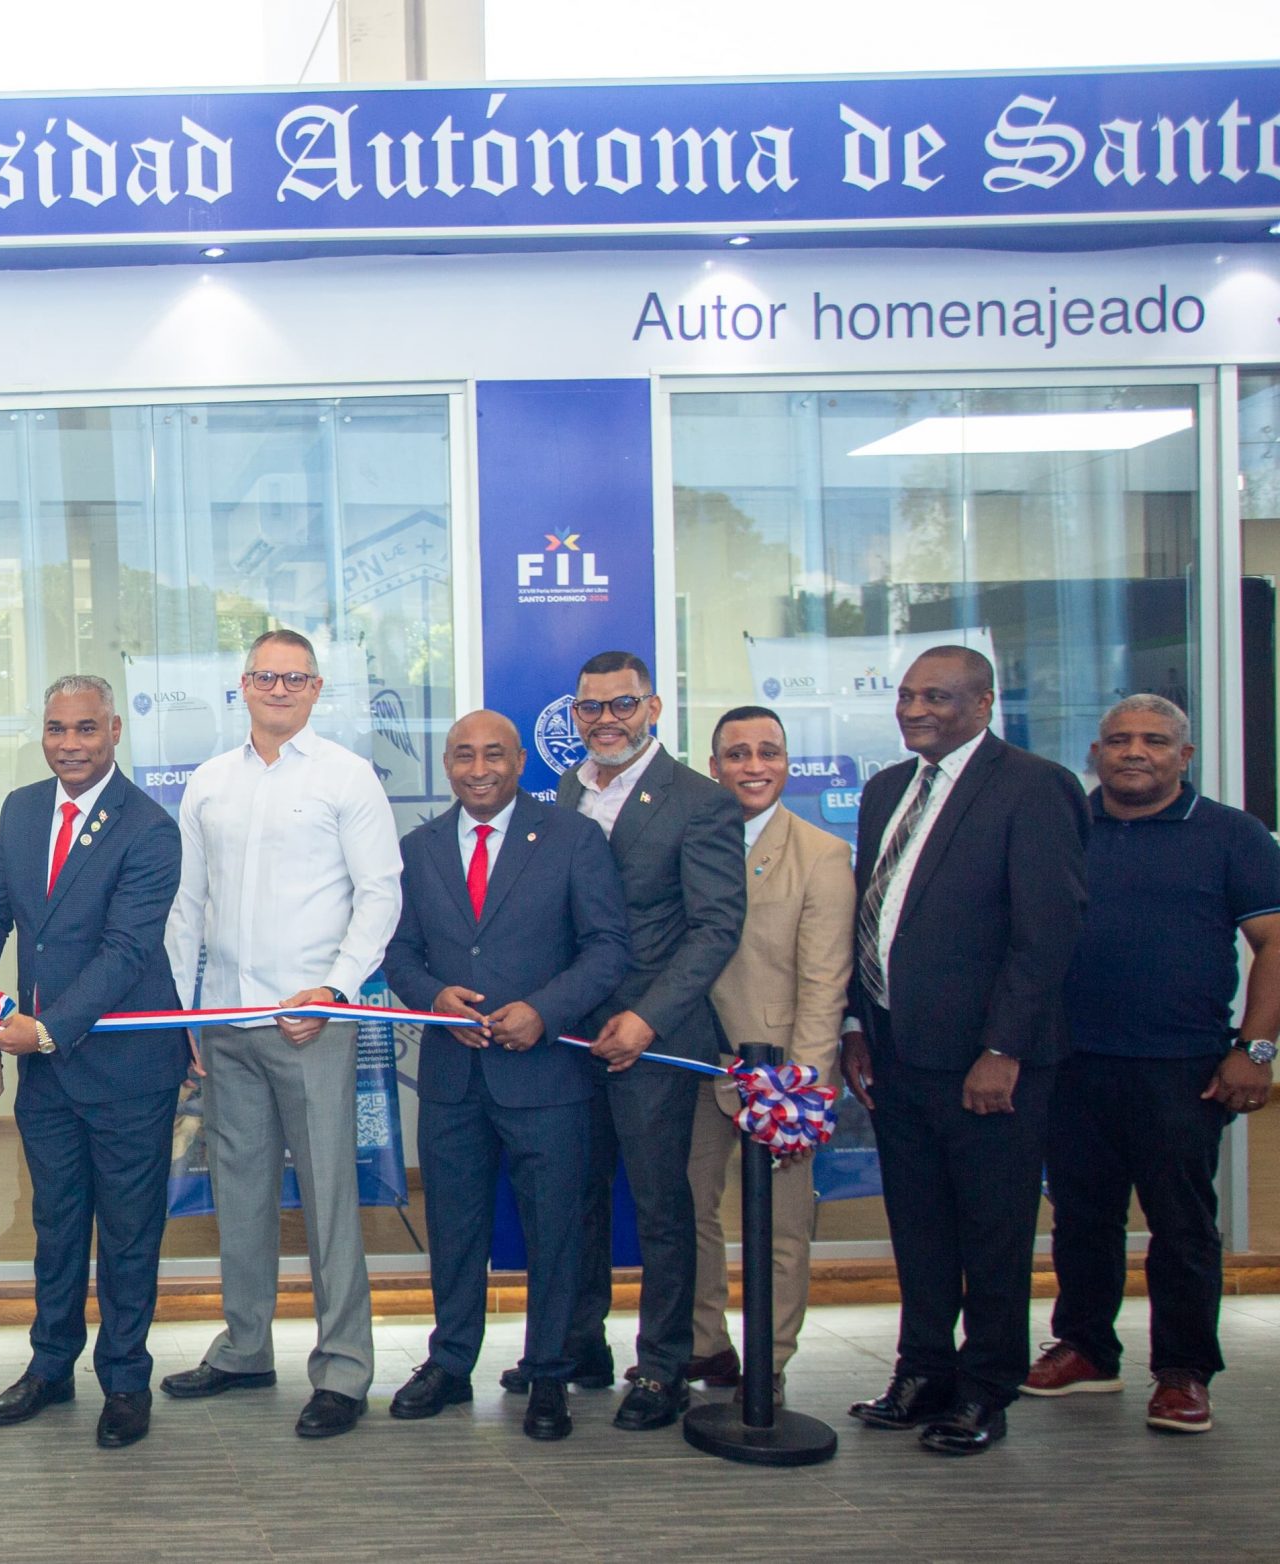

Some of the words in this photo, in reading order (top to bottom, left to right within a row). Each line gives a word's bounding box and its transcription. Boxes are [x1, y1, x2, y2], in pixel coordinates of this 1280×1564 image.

[275, 92, 799, 203] Autónoma
[839, 102, 947, 192] de
[632, 291, 787, 342] Autor
[813, 284, 1206, 349] homenajeado
[517, 552, 609, 587] FIL
[518, 595, 546, 603] SANTO
[547, 595, 587, 603] DOMINGO
[854, 675, 895, 690] FIL
[788, 761, 840, 777] CUELA
[145, 770, 193, 787] ESCU
[830, 777, 847, 787] de
[356, 1062, 390, 1070] alibración
[357, 1055, 389, 1063] ectrónica
[357, 1078, 384, 1088] enos!
